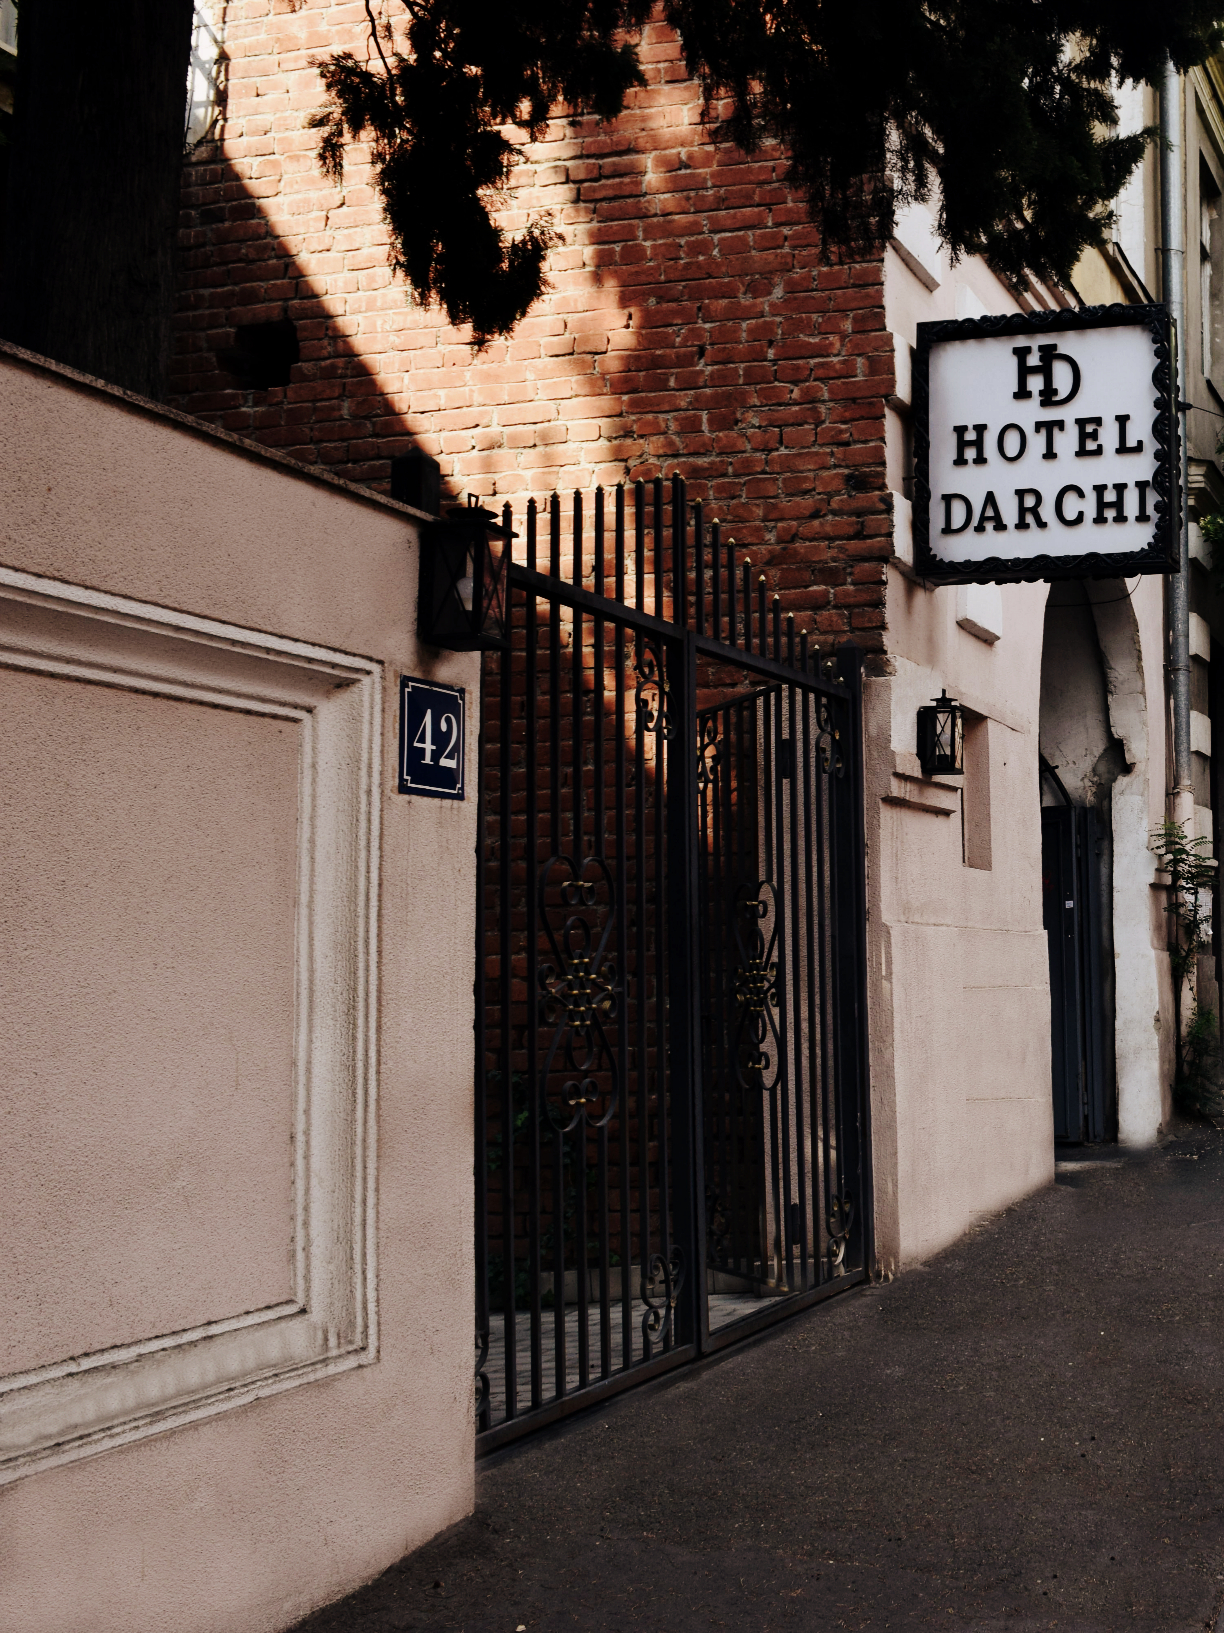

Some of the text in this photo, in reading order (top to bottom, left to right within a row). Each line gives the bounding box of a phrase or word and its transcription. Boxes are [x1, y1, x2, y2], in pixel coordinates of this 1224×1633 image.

[1012, 343, 1081, 408] HD
[952, 414, 1144, 466] HOTEL
[941, 480, 1151, 534] DARCHI
[413, 708, 458, 769] 42
